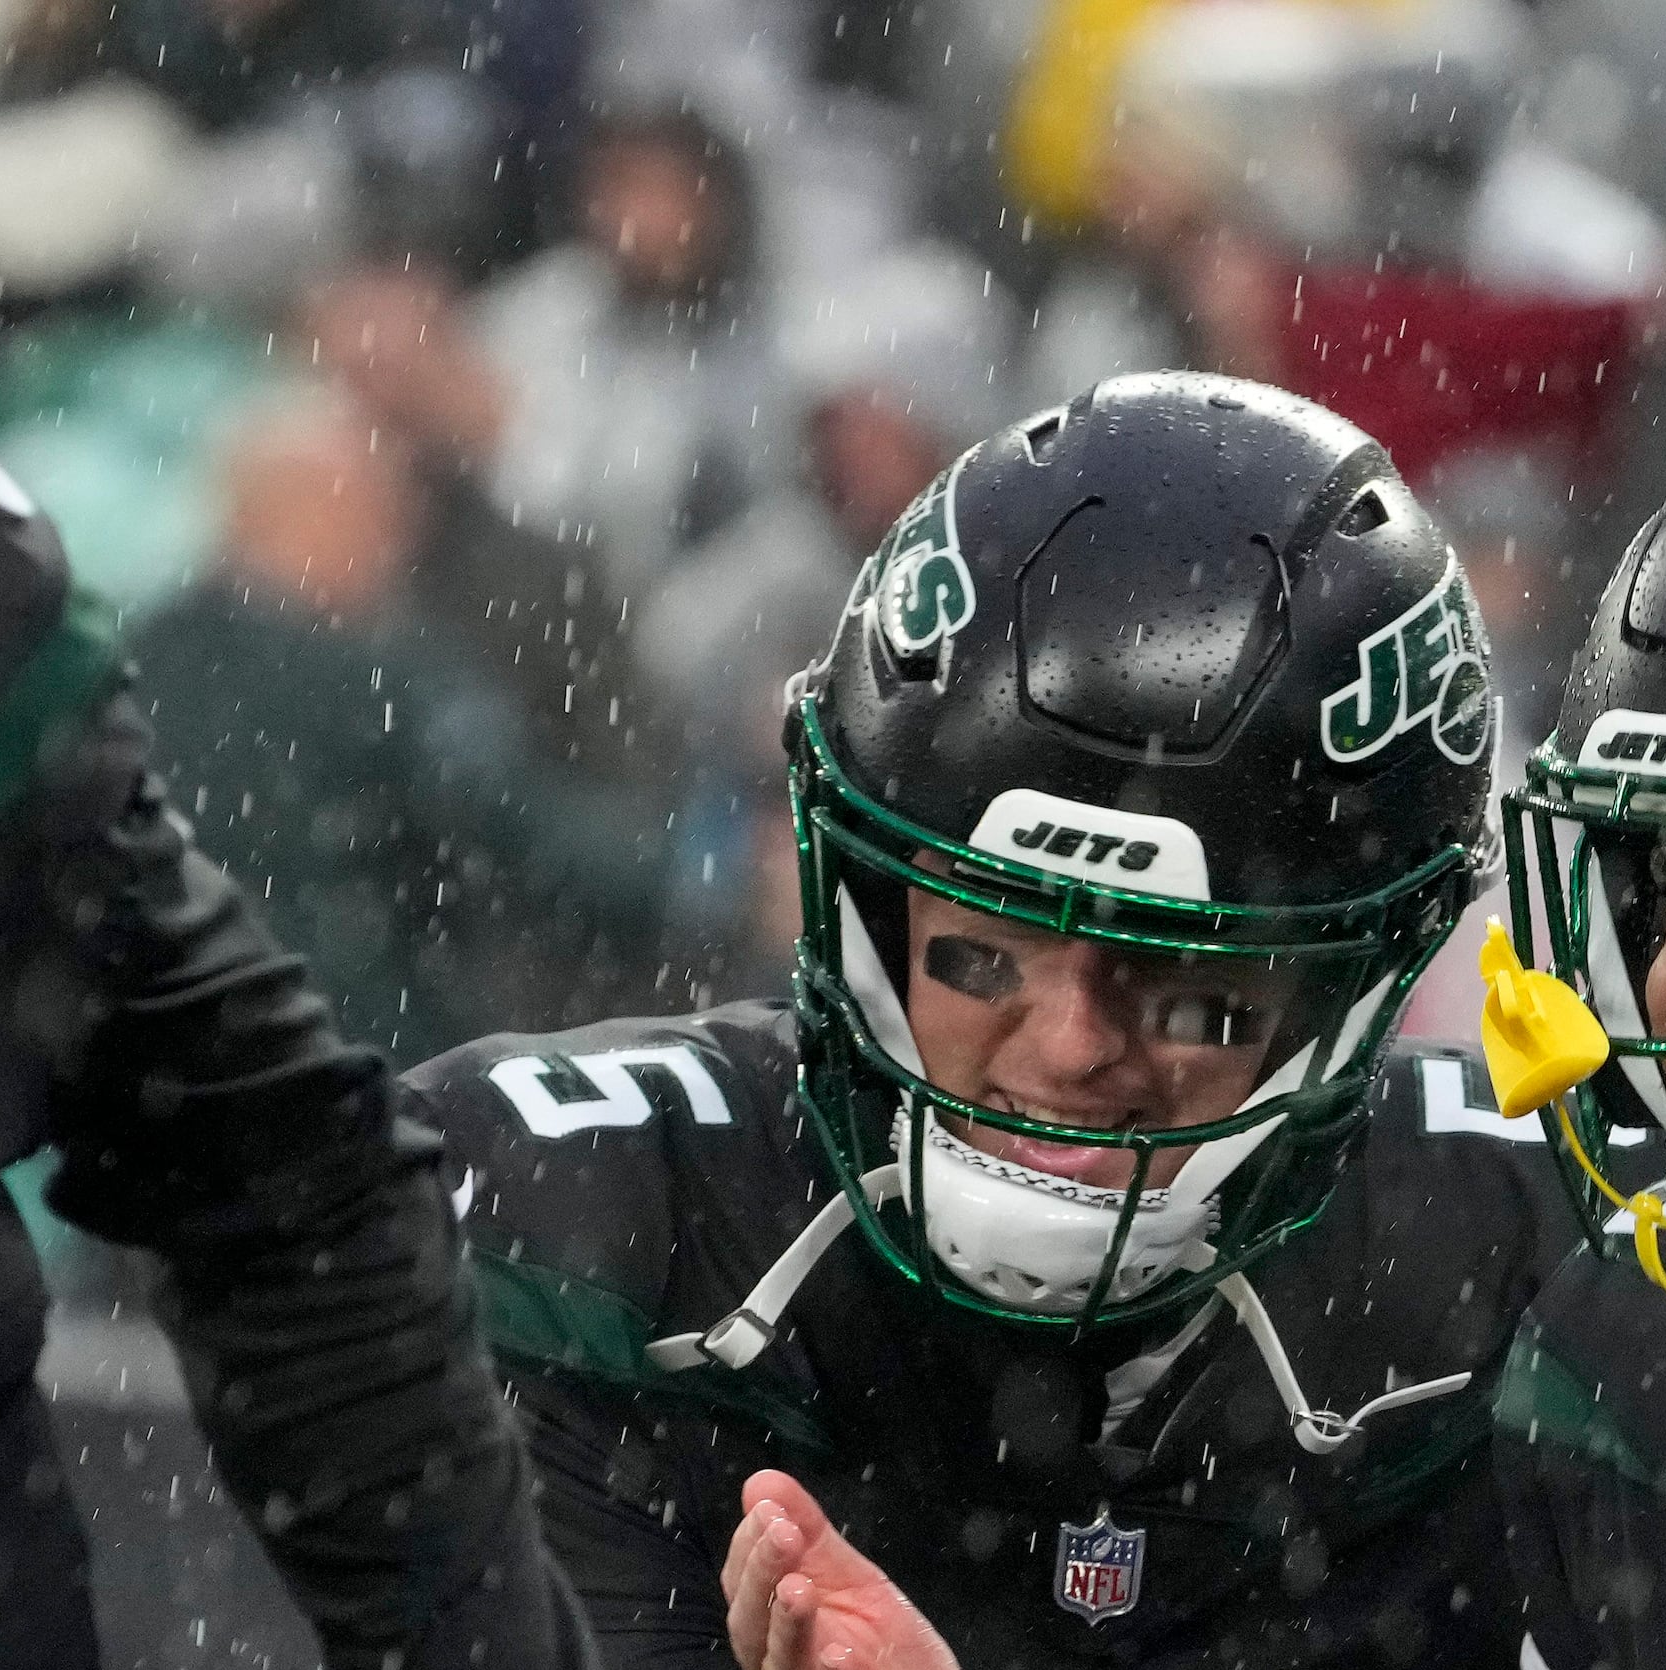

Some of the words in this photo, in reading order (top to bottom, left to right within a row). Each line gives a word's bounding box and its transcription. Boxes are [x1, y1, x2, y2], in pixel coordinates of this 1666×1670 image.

[1011, 820, 1160, 872] JETS
[487, 1045, 733, 1139] 5
[1069, 1564, 1126, 1606] NFL
